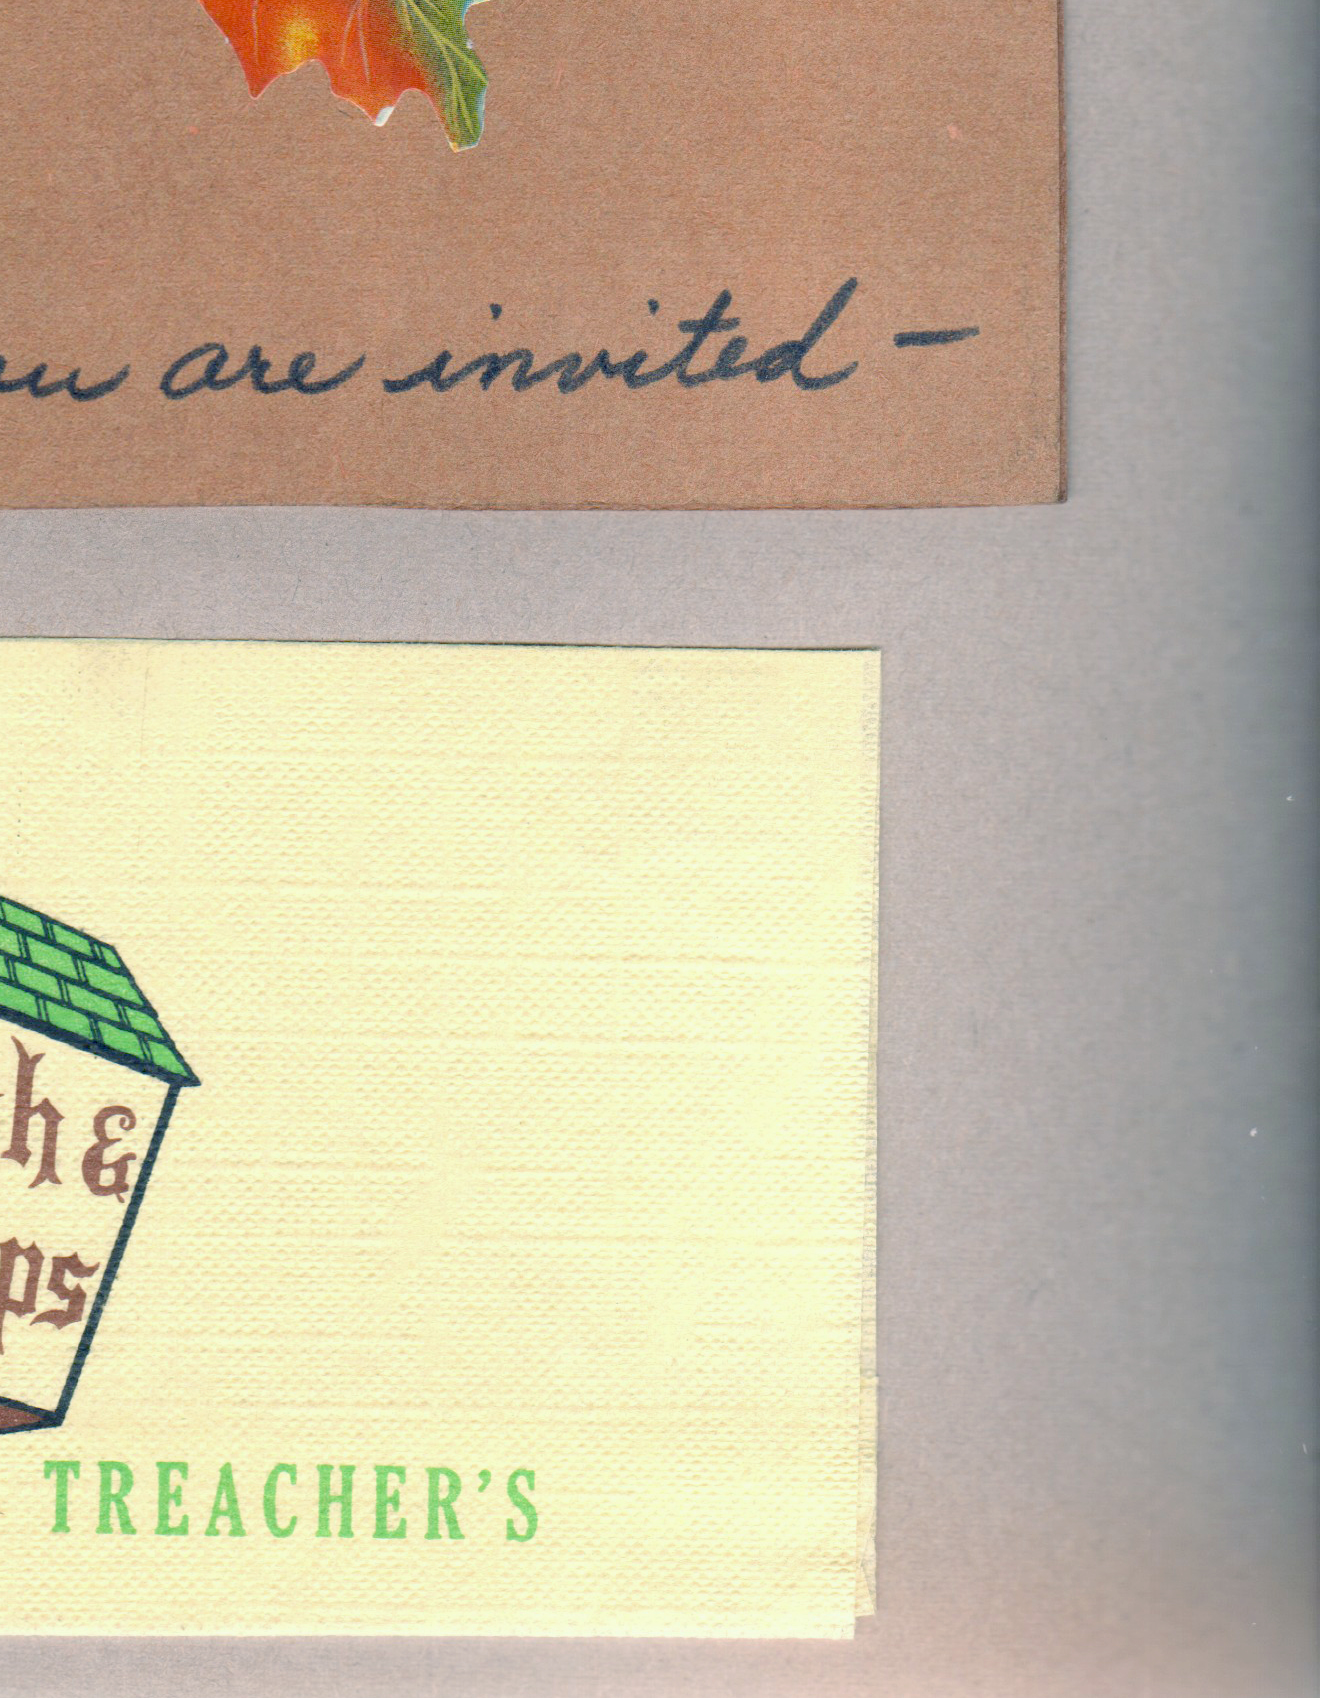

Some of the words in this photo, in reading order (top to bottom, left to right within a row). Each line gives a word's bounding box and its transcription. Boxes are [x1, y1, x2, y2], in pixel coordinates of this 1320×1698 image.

[160, 343, 365, 400] are
[383, 278, 857, 394] invited
[80, 1105, 137, 1203] &
[45, 1462, 537, 1542] TREACHER'S
